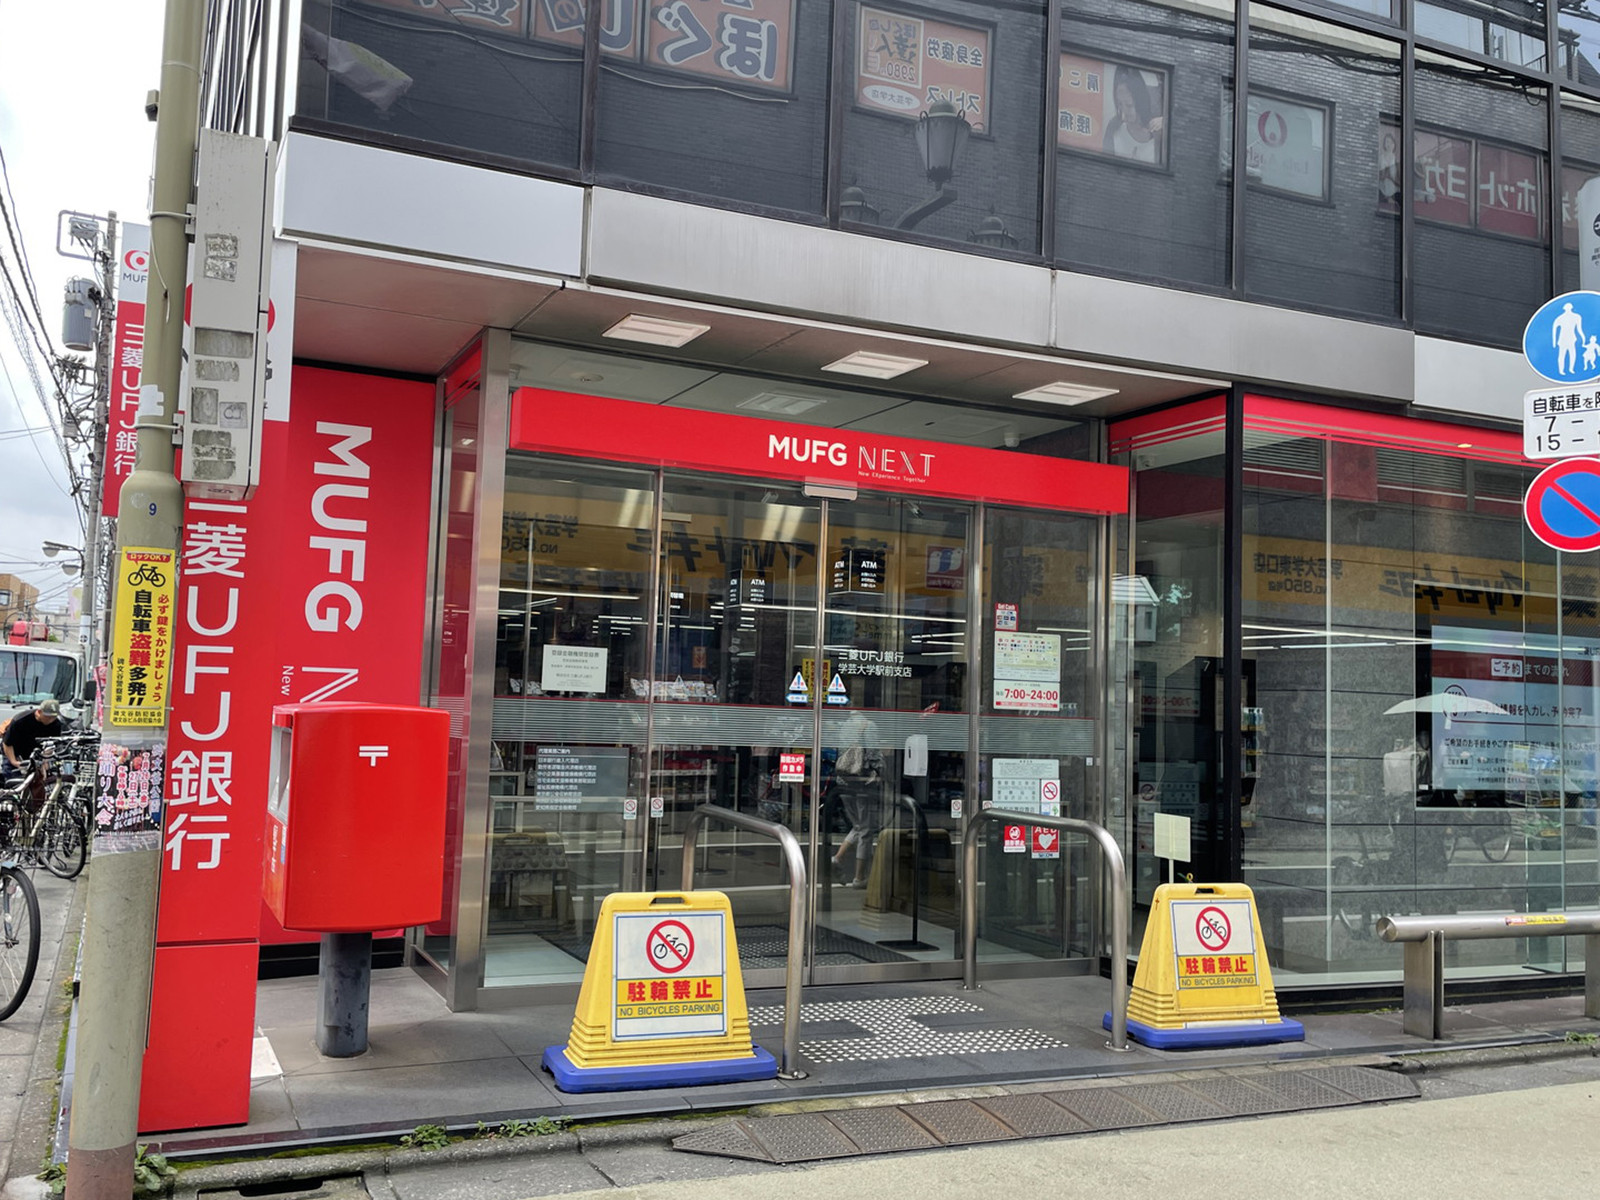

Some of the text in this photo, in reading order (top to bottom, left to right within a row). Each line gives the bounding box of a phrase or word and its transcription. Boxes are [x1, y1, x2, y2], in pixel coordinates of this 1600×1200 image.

[769, 434, 936, 477] MUFG NEXT
[149, 503, 157, 516] 9
[305, 421, 372, 632] MUFG
[860, 560, 877, 569] ATM
[152, 594, 170, 703] 必ず鍵をかけましょう
[838, 651, 904, 663] 三菱UFJ銀行
[837, 663, 912, 678] 学芸大学駅前支店
[1493, 659, 1521, 675] ご予約
[281, 665, 294, 696] New
[1185, 956, 1248, 975] 駐輪禁止
[1181, 977, 1254, 986] NO BICYCLES PARKING
[627, 979, 713, 1002] 駐輪禁止
[620, 1003, 720, 1016] NO BICYCLES PARKING
